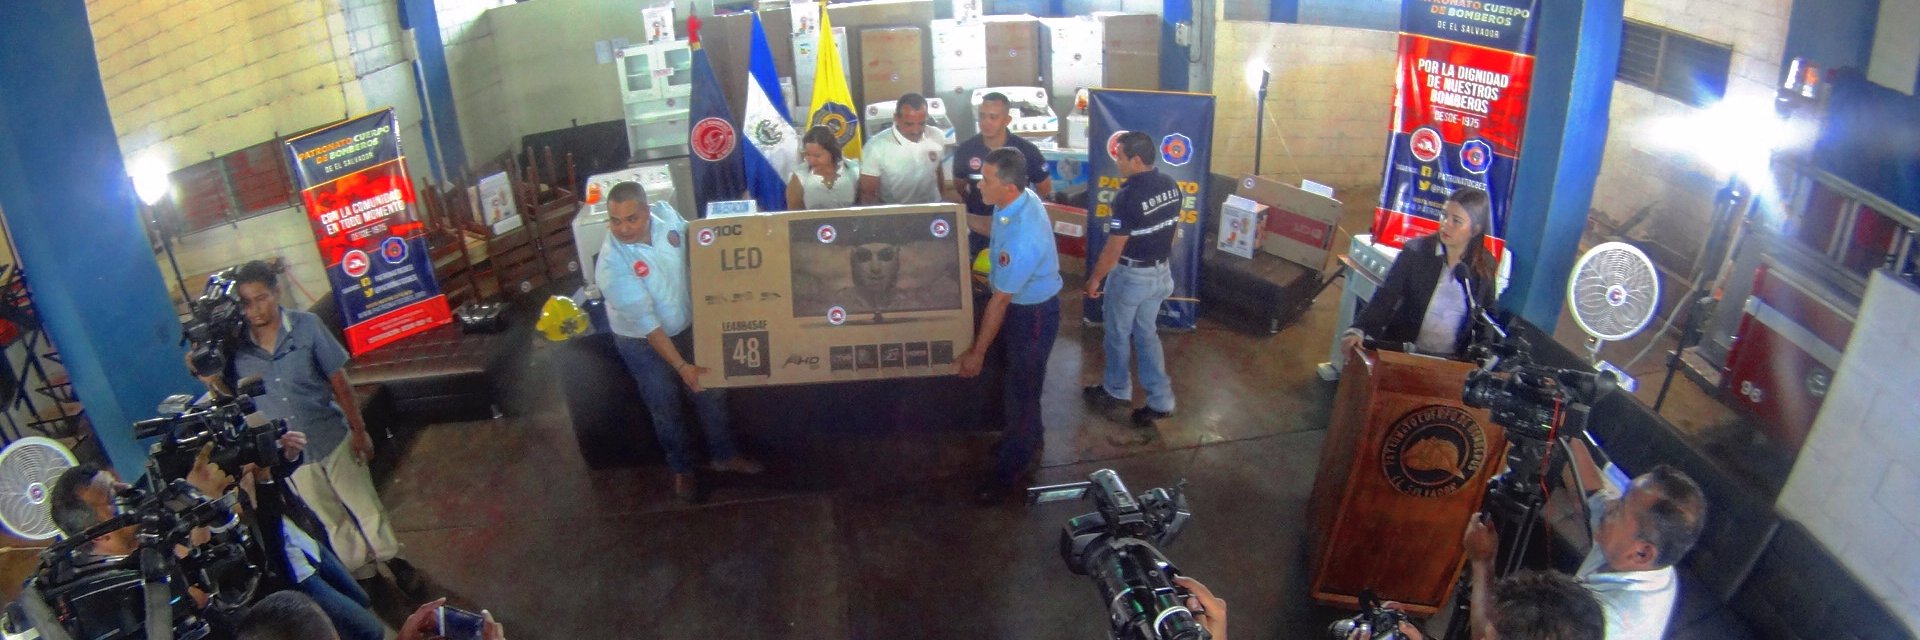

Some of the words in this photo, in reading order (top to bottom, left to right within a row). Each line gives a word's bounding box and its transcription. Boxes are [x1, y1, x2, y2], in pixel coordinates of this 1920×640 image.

[1430, 5, 1447, 15] DE
[1447, 7, 1512, 26] BOMBEROS
[1483, 3, 1530, 18] CUERPO
[1437, 20, 1447, 29] DE
[1449, 22, 1458, 31] EL
[1460, 24, 1500, 39] SALVADOR
[1418, 58, 1439, 74] POR
[1441, 62, 1455, 77] LA
[1457, 65, 1509, 88] DIGNIDAD
[1426, 74, 1441, 89] DE
[1443, 77, 1500, 101] NUESTROS
[1430, 88, 1489, 114] BOMBEROS
[353, 125, 390, 142] CUERPO
[339, 206, 352, 219] LA
[351, 188, 403, 214] COMUNIDAD
[339, 214, 363, 230] TODO
[362, 200, 406, 223] MOMENTO
[720, 247, 763, 271] LED
[732, 337, 761, 368] 48
[1740, 380, 1762, 403] 96
